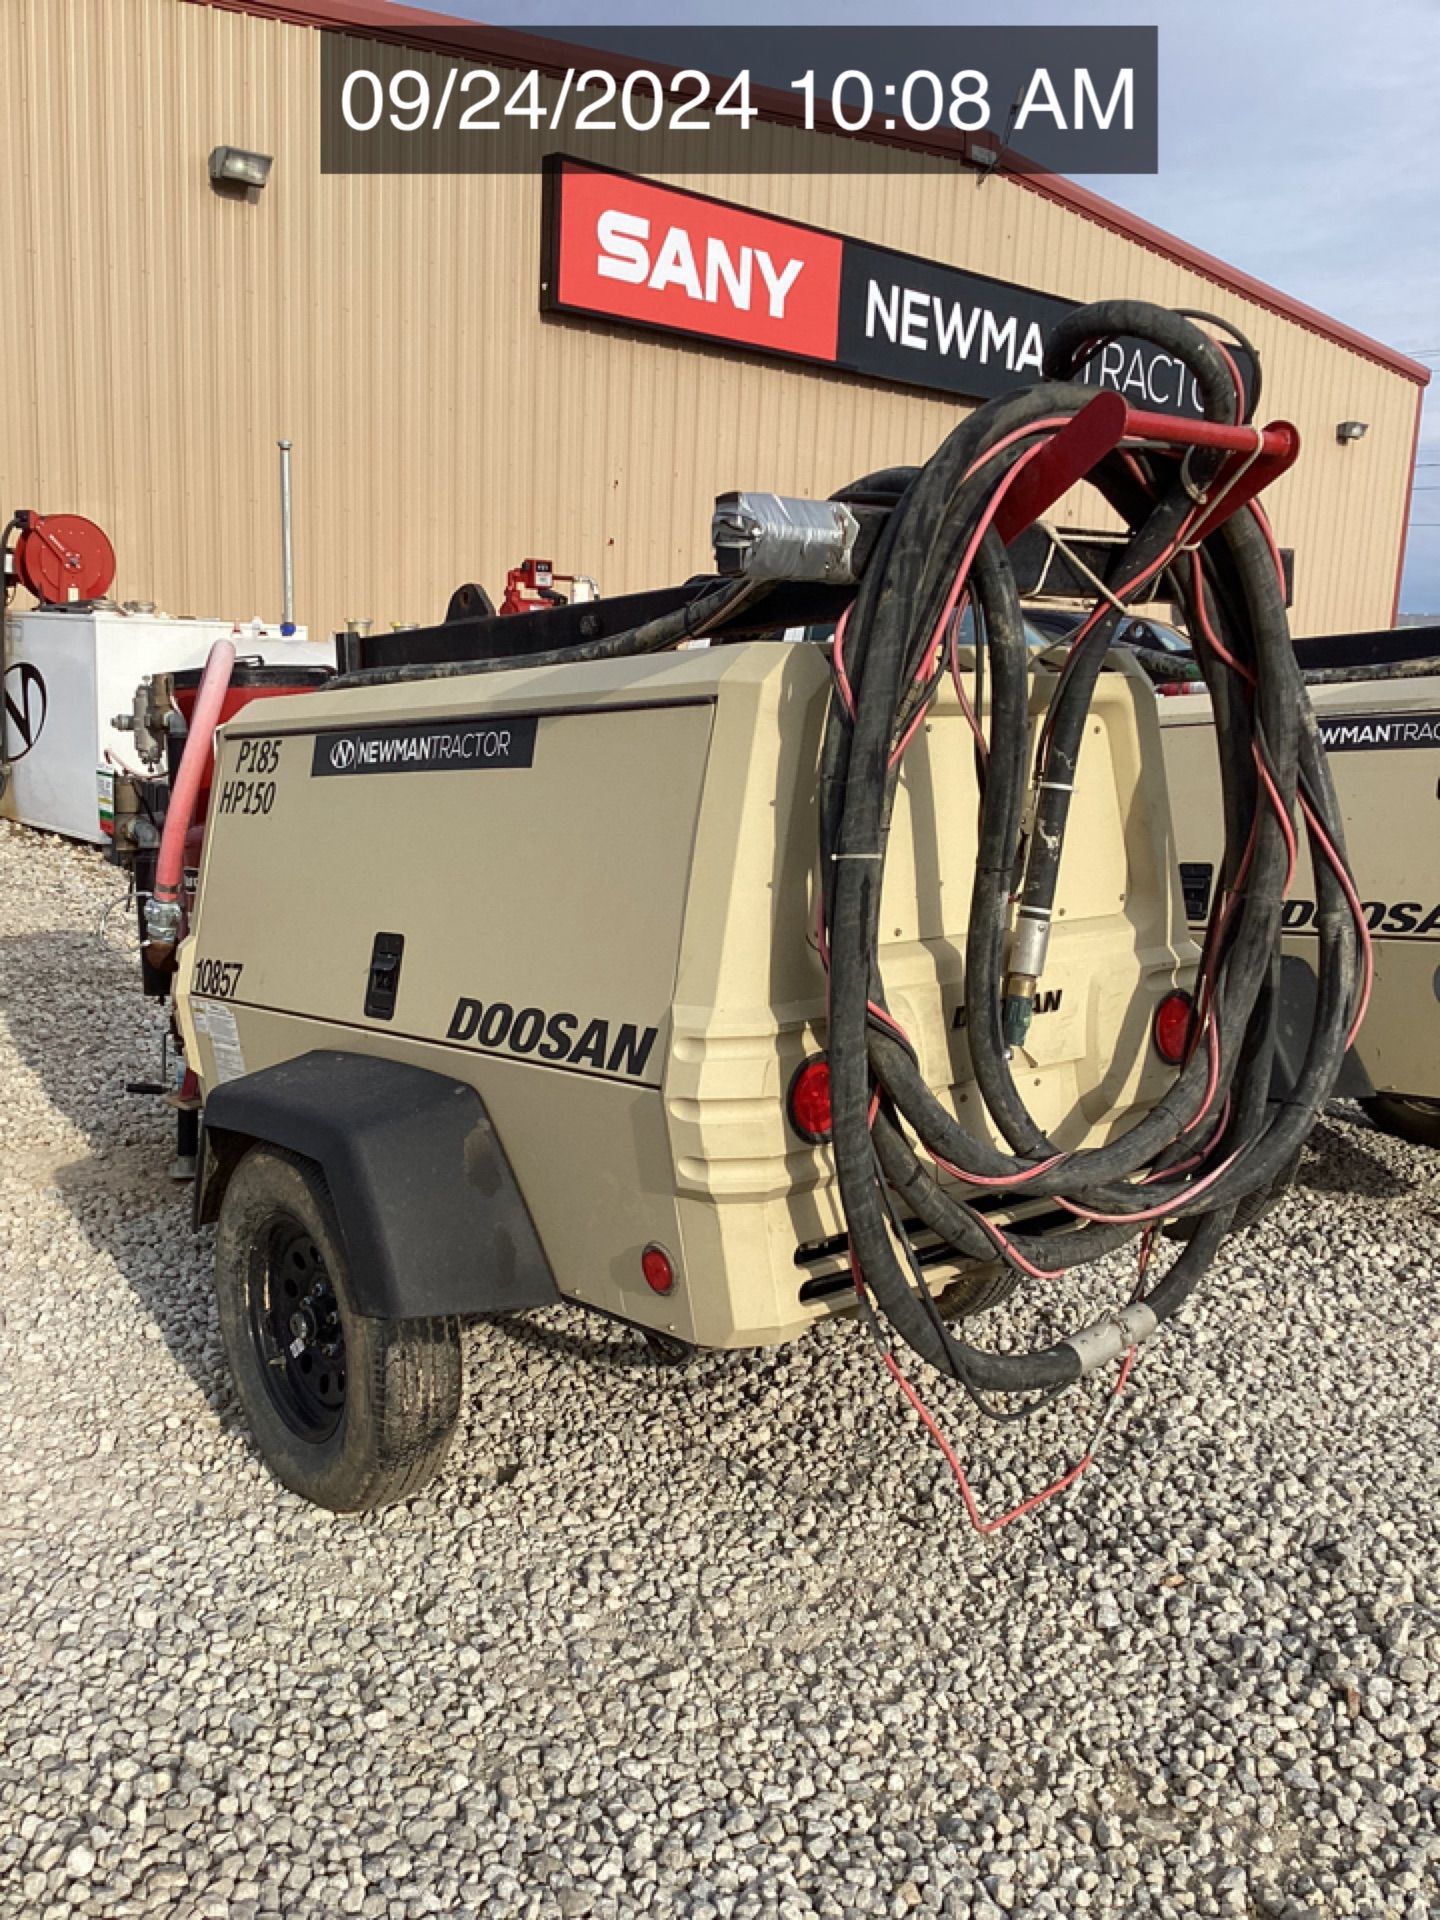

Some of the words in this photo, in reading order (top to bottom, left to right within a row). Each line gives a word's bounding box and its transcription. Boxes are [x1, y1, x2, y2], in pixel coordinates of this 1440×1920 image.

[597, 209, 805, 319] SANY
[236, 740, 282, 773] P185
[219, 781, 276, 814] HP150
[195, 959, 244, 997] 10857
[446, 997, 658, 1076] DOOSAN
